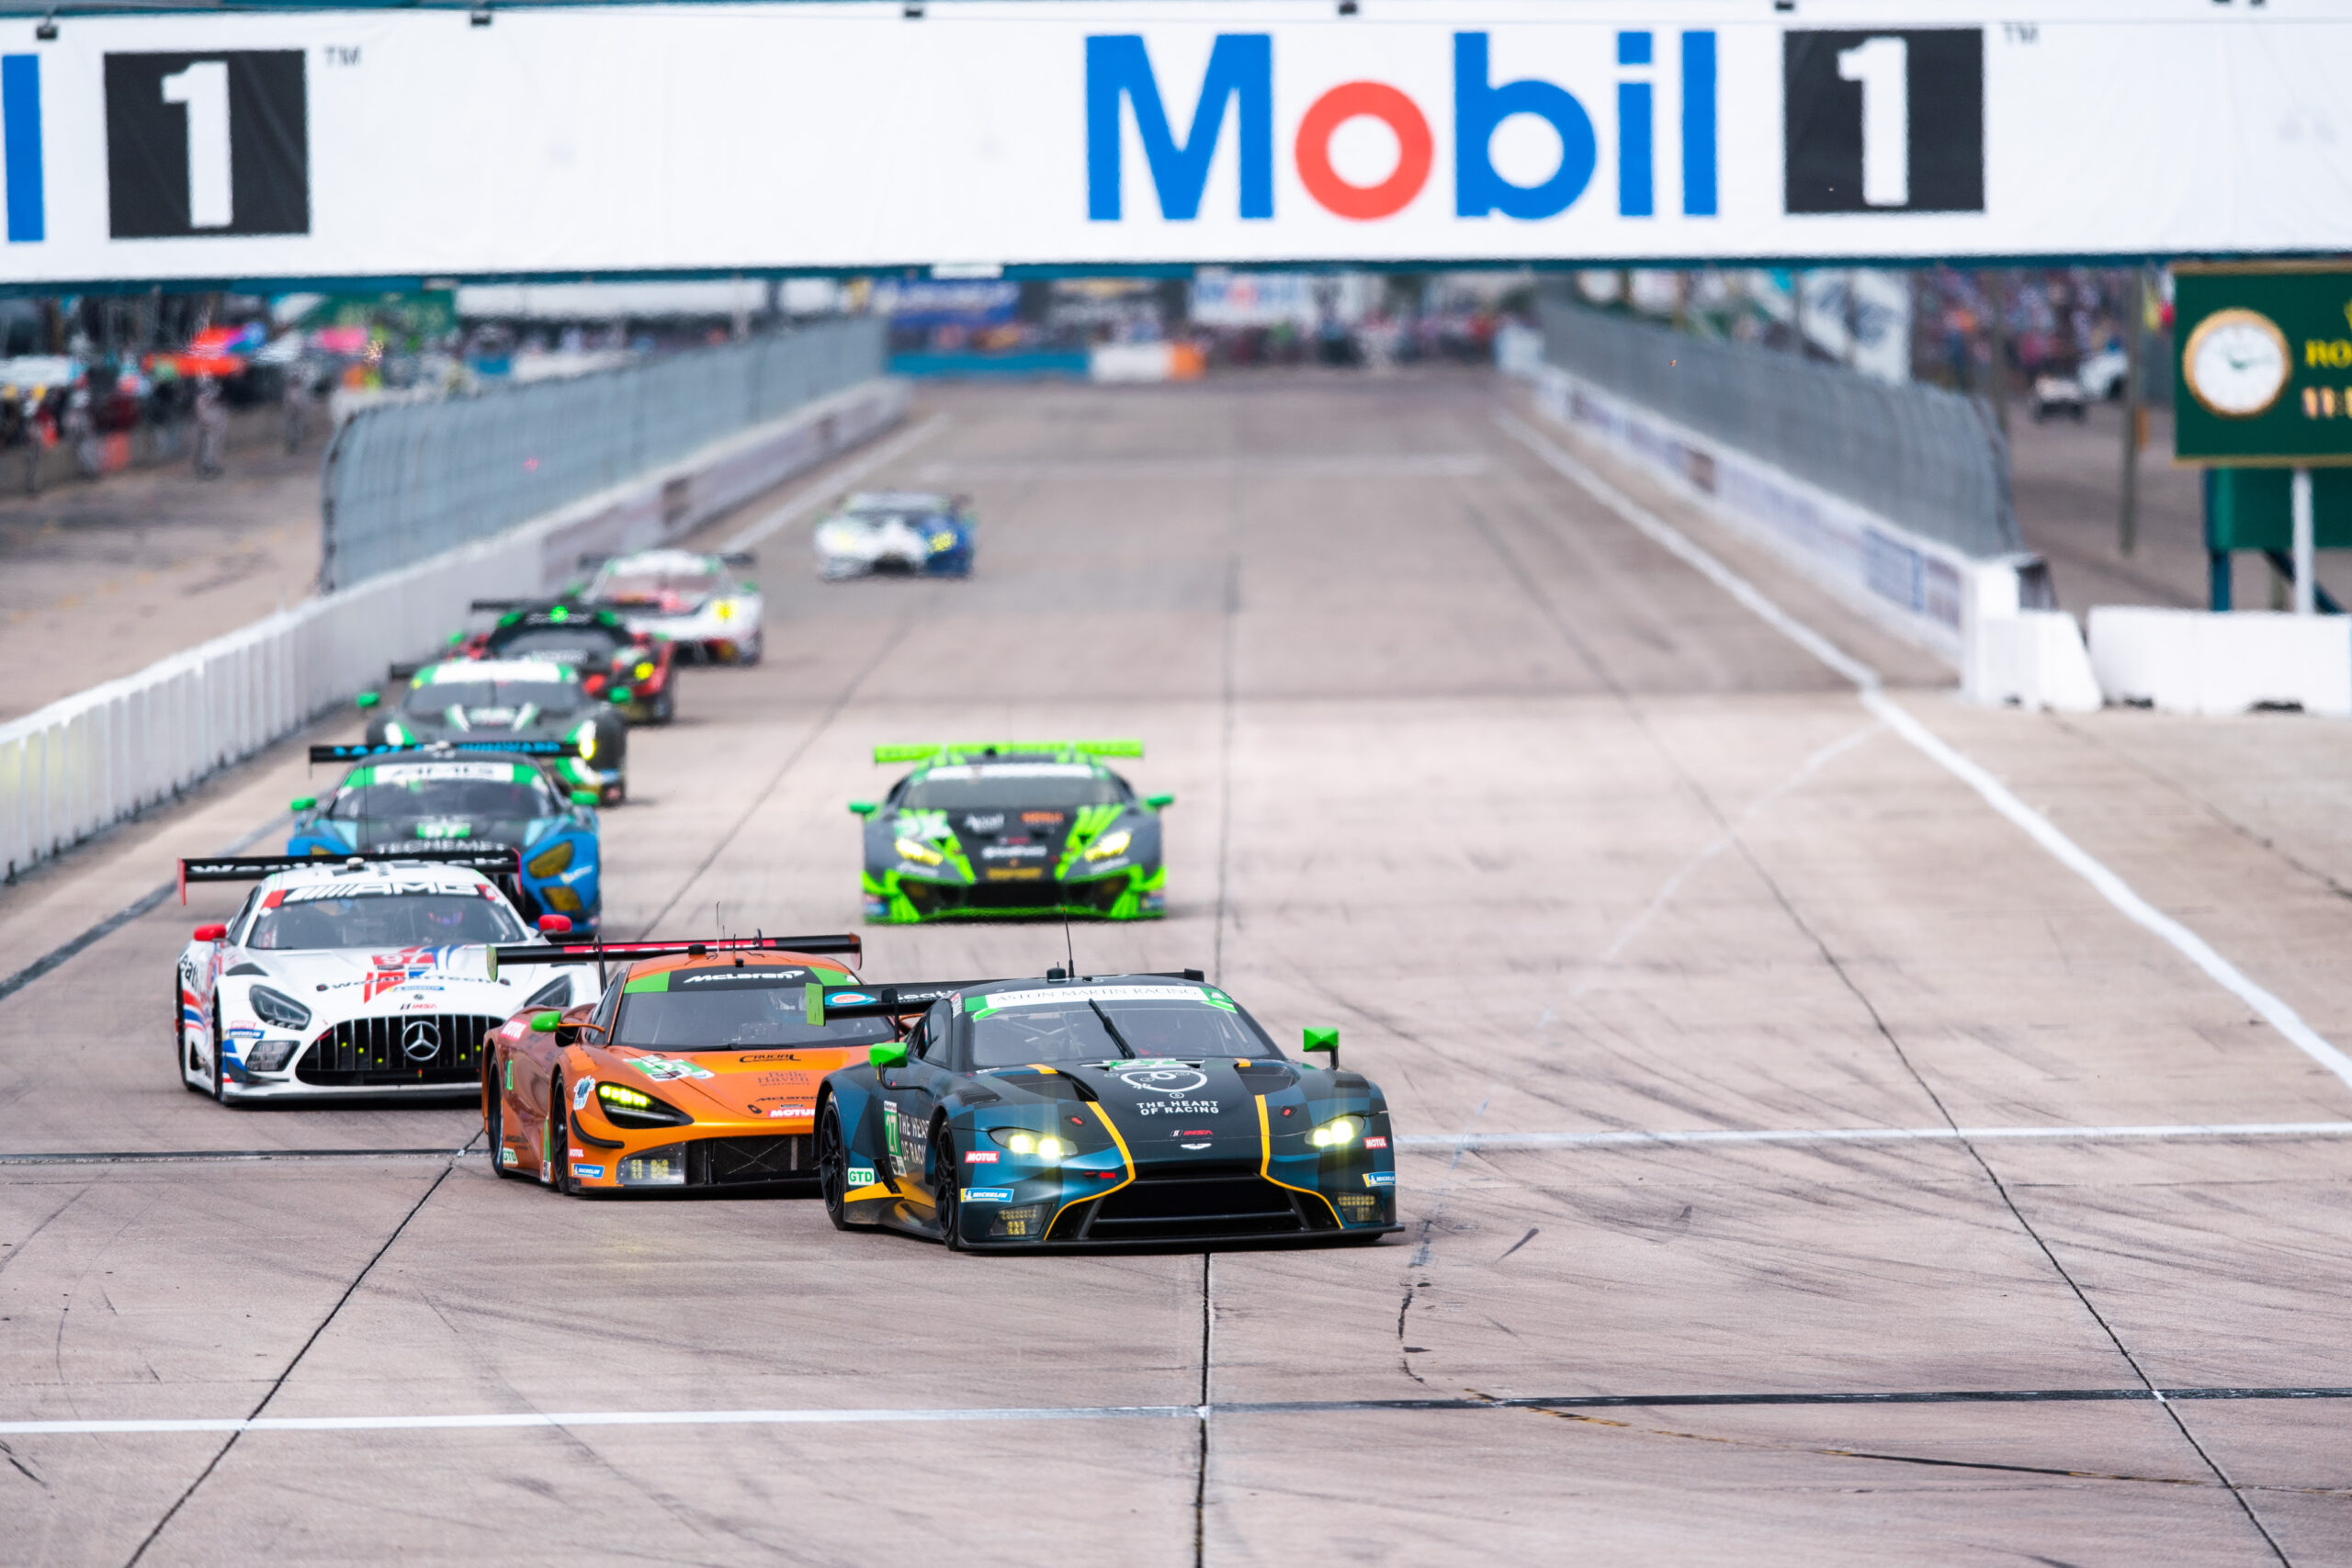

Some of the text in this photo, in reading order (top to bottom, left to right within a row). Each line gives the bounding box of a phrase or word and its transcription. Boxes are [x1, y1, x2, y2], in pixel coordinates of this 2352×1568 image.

[323, 46, 362, 66] TM
[1087, 31, 1908, 220] Mobil 1
[162, 61, 233, 229] 1
[350, 882, 479, 897] AMG
[684, 970, 805, 984] McLaren
[996, 986, 1198, 1002] ASTON MARTIN RACING
[1164, 1106, 1219, 1114] RACING
[898, 1112, 911, 1136] THE
[886, 1114, 899, 1154] 27
[1365, 1138, 1386, 1147] MOTUL
[966, 1153, 997, 1161] MOTUL
[849, 1170, 873, 1182] GTD
